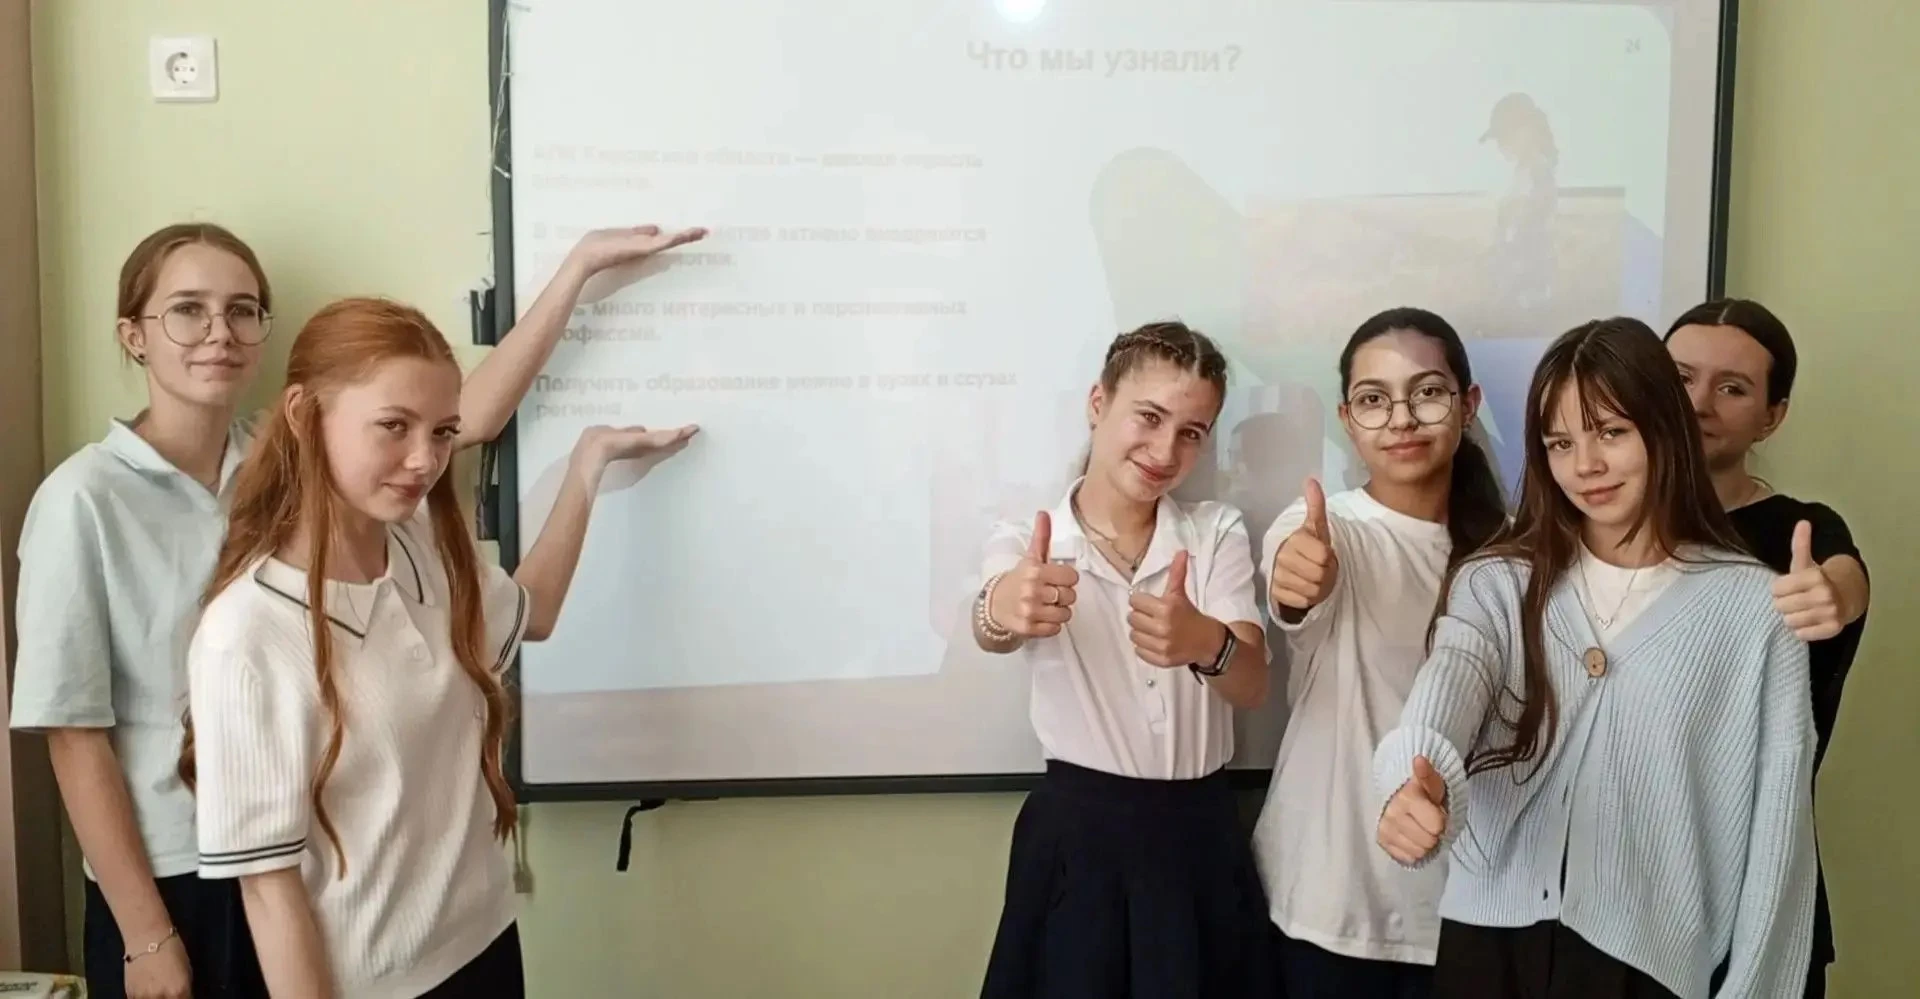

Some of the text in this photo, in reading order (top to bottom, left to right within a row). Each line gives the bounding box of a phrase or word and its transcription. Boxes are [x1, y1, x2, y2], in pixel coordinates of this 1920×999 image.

[966, 40, 1242, 78] Что мы узнали?
[592, 302, 655, 317] много
[663, 302, 787, 320] интересных
[561, 324, 662, 345] офессий.
[535, 374, 639, 396] Получить
[646, 373, 780, 398] образование
[954, 371, 1018, 390] ссузах
